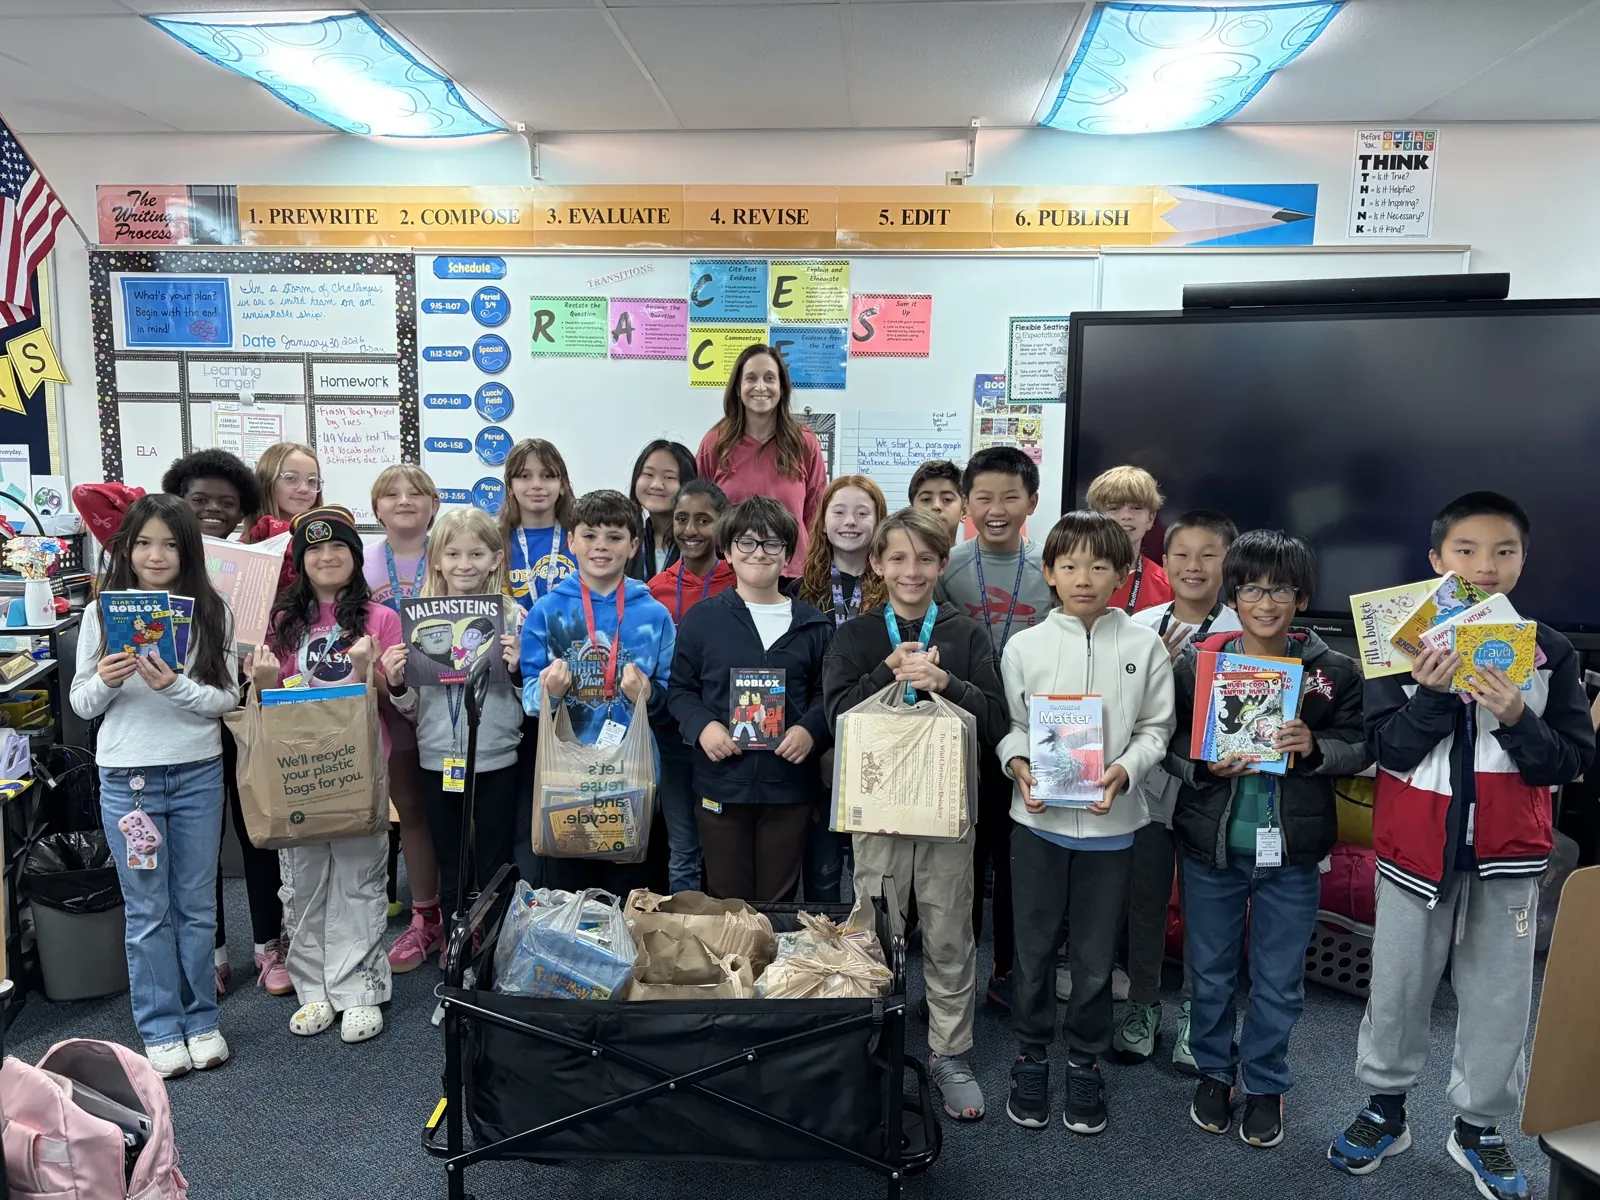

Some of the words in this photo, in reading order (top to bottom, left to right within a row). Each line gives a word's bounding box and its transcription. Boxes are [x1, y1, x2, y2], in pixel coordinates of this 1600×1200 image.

[1360, 132, 1381, 140] Before
[1359, 155, 1429, 170] THINK
[1362, 173, 1369, 182] T
[1391, 172, 1409, 180] True?
[1360, 186, 1369, 194] H
[1389, 185, 1415, 196] Helpful?
[127, 190, 157, 206] The
[1361, 198, 1365, 206] I
[1388, 199, 1419, 209] Inspiring?
[112, 206, 173, 227] Writing
[249, 209, 263, 224] 1.
[269, 208, 378, 225] PREWRITE
[400, 210, 414, 225] 2.
[421, 209, 520, 225] COMPOSE
[546, 208, 562, 224] 3.
[568, 208, 670, 224] EVALUATE
[710, 210, 727, 225] 4.
[732, 209, 810, 225] REVISE
[879, 210, 896, 226] 5.
[902, 210, 950, 226] EDIT
[1016, 210, 1032, 226] 6.
[1038, 210, 1130, 226] PUBLISH
[1358, 212, 1366, 220] N
[1387, 212, 1424, 222] Necessary?
[115, 224, 172, 240] Process
[1356, 225, 1364, 233] K
[1386, 225, 1405, 233] Kind?
[448, 262, 491, 273] Schedule
[587, 264, 653, 288] TRANSITIONS
[240, 280, 264, 295] In
[270, 284, 278, 292] a
[282, 283, 315, 293] storm
[319, 283, 329, 297] of
[691, 274, 714, 308] C
[773, 276, 798, 308] E
[134, 291, 165, 300] What's
[169, 294, 190, 303] your
[195, 291, 217, 303] plan?
[311, 296, 336, 306] team
[136, 307, 157, 320] Begin
[162, 307, 180, 316] with
[184, 308, 199, 316] the
[203, 308, 217, 316] end
[148, 323, 170, 333] mind!
[532, 310, 555, 343] R
[611, 312, 635, 345] A
[852, 308, 877, 342] S
[243, 334, 276, 347] Date
[281, 335, 328, 352] January
[479, 346, 503, 354] Specials
[693, 339, 714, 370] C
[22, 343, 46, 373] S
[204, 364, 261, 378] Learning
[213, 377, 256, 390] Target
[320, 376, 389, 387] Homework
[320, 406, 345, 416] Finish
[326, 418, 339, 429] by
[338, 433, 362, 442] Vocab
[366, 432, 379, 440] test
[137, 446, 157, 456] ELA
[338, 446, 361, 454] Vocab
[364, 446, 385, 454] online
[876, 438, 887, 447] We
[891, 438, 912, 449] start
[925, 442, 961, 452] paragraph
[364, 455, 377, 463] due
[858, 447, 867, 459] by
[868, 448, 904, 460] indenting.
[908, 448, 926, 460] Every
[927, 450, 945, 458] other
[858, 458, 890, 466] sentence
[1129, 580, 1140, 606] Southwest
[405, 600, 498, 620] VALENSTEINS
[1360, 602, 1377, 639] bucket
[308, 651, 351, 663] NASA
[1363, 648, 1385, 666] fill
[1477, 647, 1511, 657] Travel
[1040, 711, 1092, 724] Matter
[277, 754, 308, 768] We'll
[312, 744, 356, 763] recycle
[282, 768, 311, 784] your
[314, 758, 354, 778] plastic
[284, 782, 316, 796] bags
[318, 778, 336, 789] for
[339, 772, 363, 788] you.
